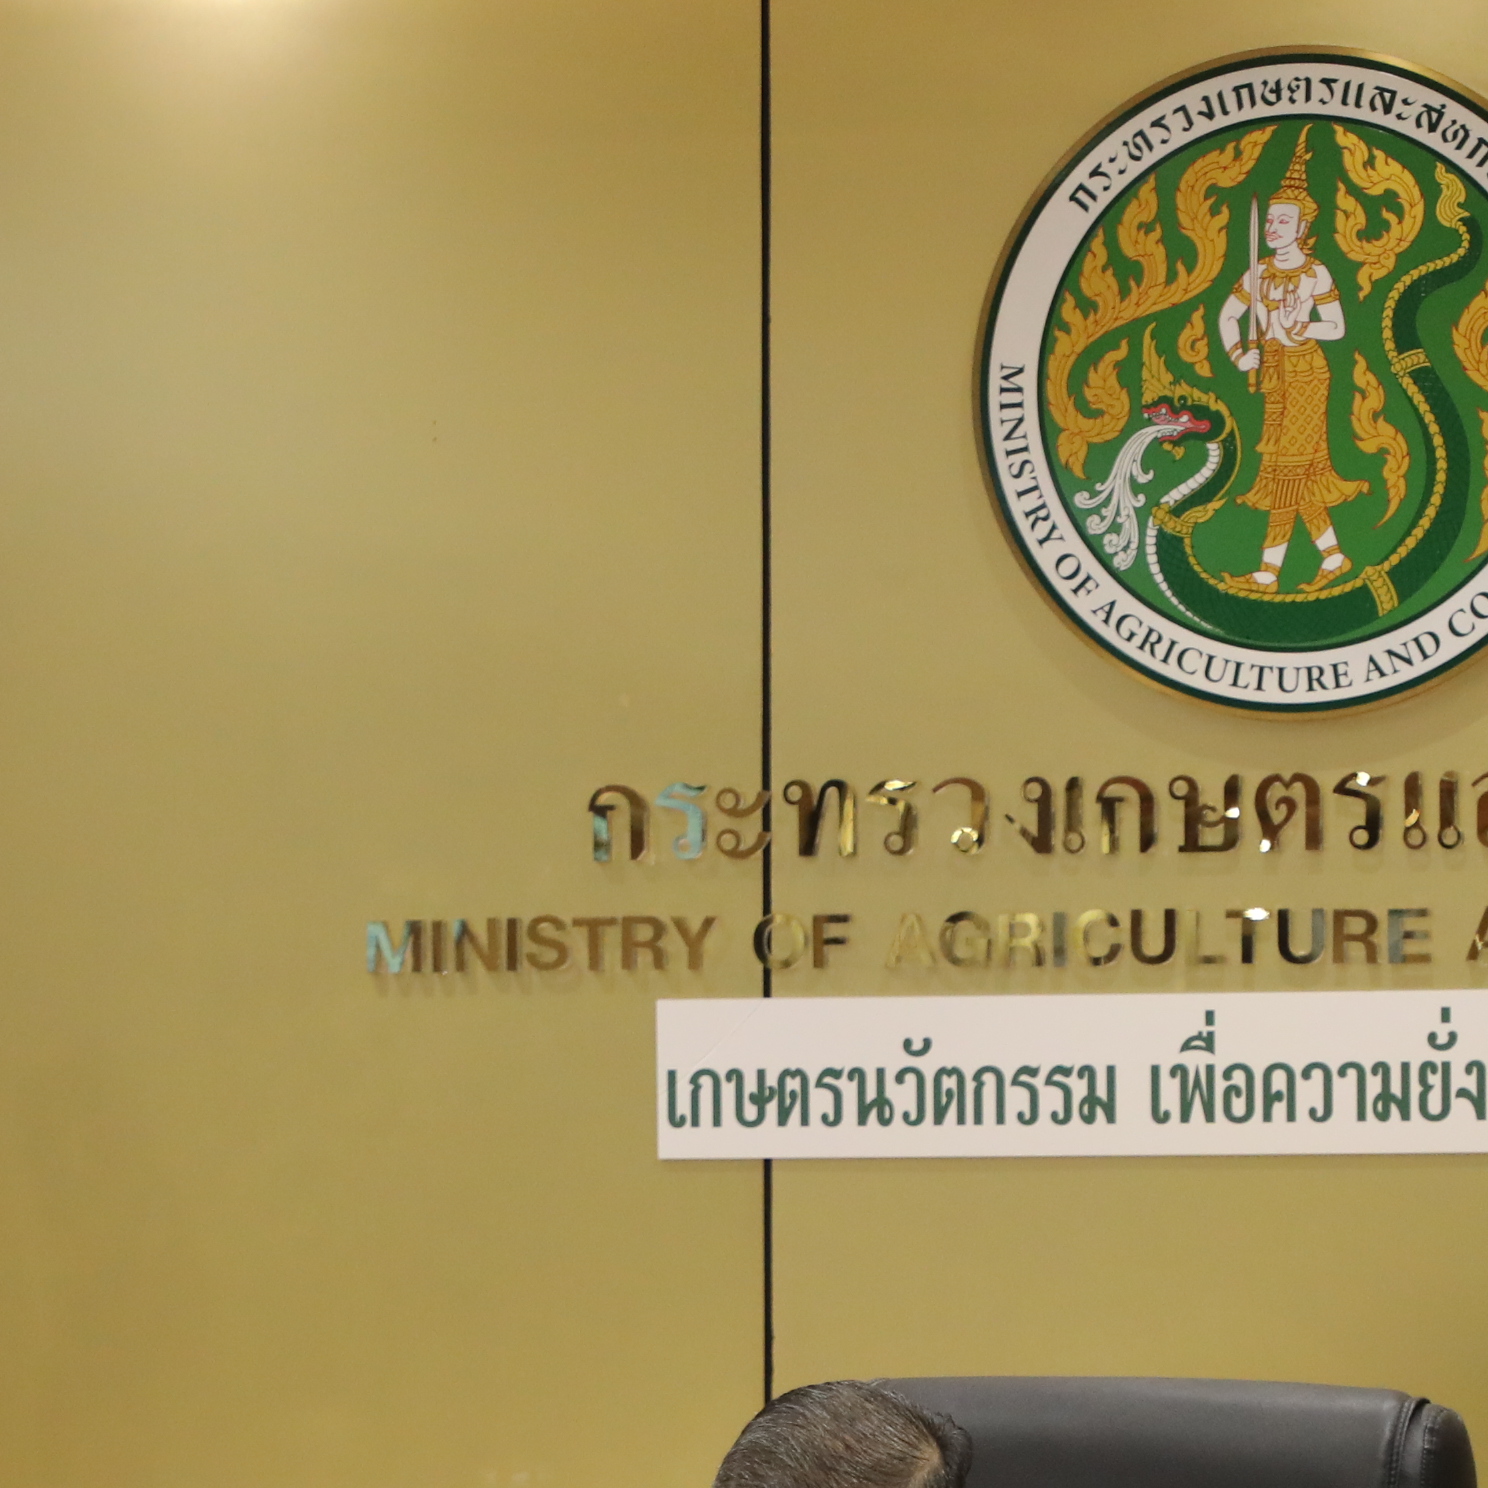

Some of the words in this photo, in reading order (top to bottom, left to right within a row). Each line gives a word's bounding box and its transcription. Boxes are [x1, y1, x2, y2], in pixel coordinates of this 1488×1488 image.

[998, 361, 1066, 551] MINISTRY
[1053, 552, 1098, 601] OF
[1090, 595, 1354, 693] AGRICULTURE
[1363, 629, 1442, 684] AND
[366, 914, 717, 976] MINISTRY
[752, 913, 851, 969] OF
[885, 906, 1433, 968] AGRICULTURE
[666, 1036, 1117, 1129] เกษตรนวัตกรรม
